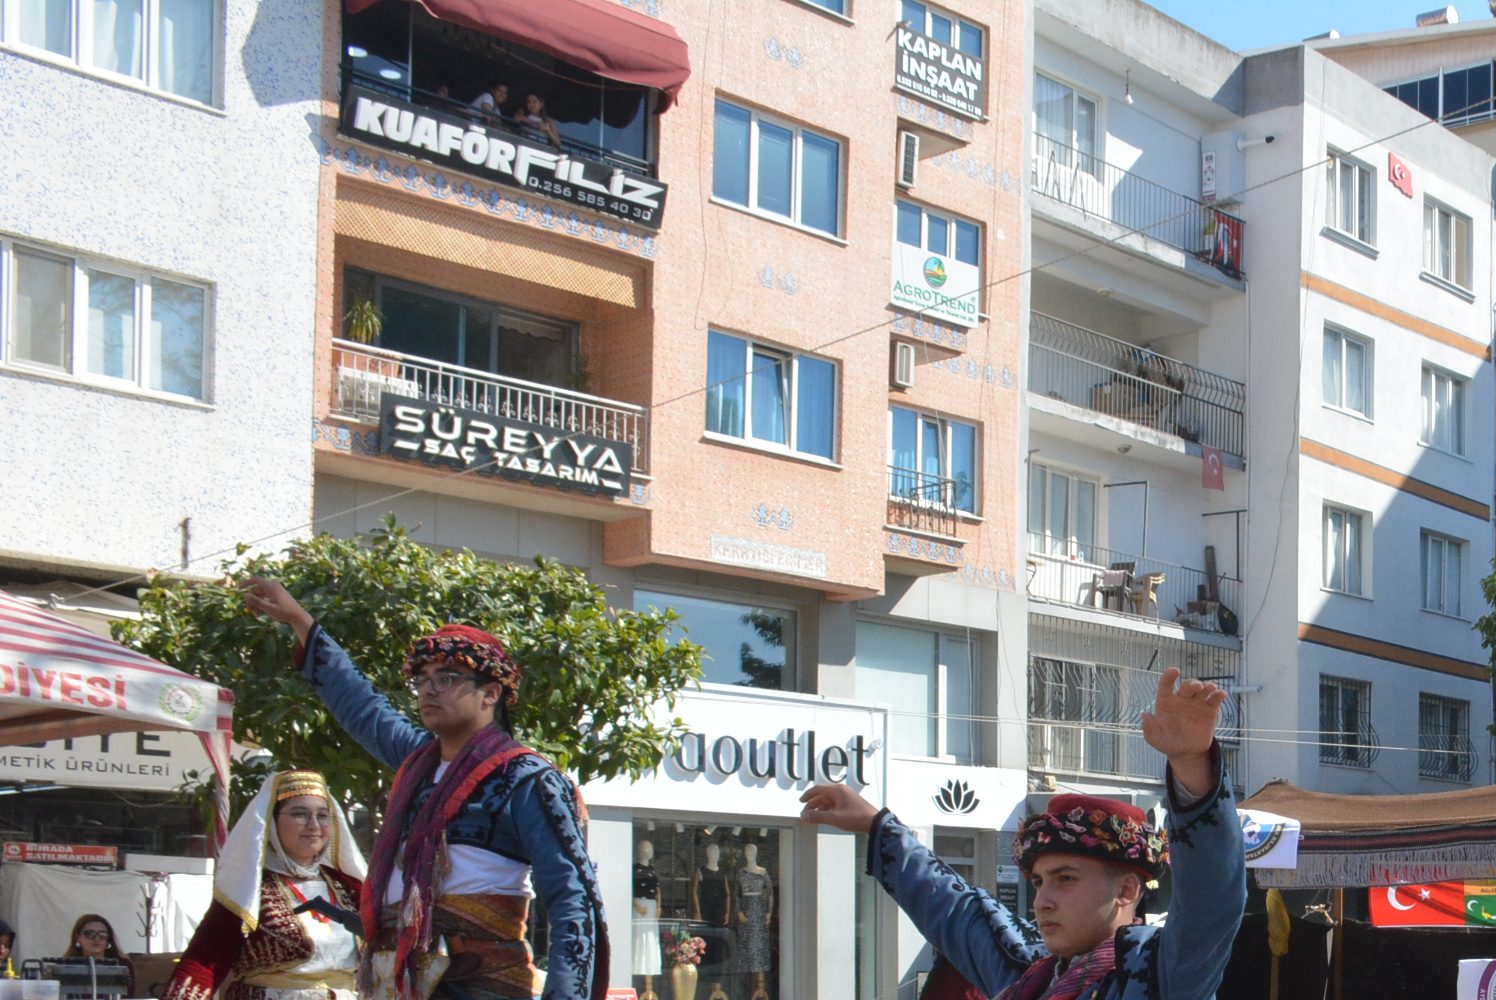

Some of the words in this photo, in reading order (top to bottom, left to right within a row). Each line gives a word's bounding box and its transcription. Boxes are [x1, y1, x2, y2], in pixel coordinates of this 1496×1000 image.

[898, 28, 982, 81] KAPLAN
[902, 49, 978, 101] İNŞAAT
[354, 97, 516, 176] KUAFÖR
[513, 145, 665, 209] FİLİZ
[528, 176, 573, 198] 0.256
[577, 189, 606, 208] 585
[610, 197, 629, 214] 40
[894, 280, 976, 315] AGROTREND
[395, 406, 625, 474] SÜREYYA
[423, 438, 477, 465] SAÇ
[493, 451, 599, 486] TASARIM
[66, 757, 170, 777] ÜRÜNLERİ
[25, 843, 73, 853] BURADA
